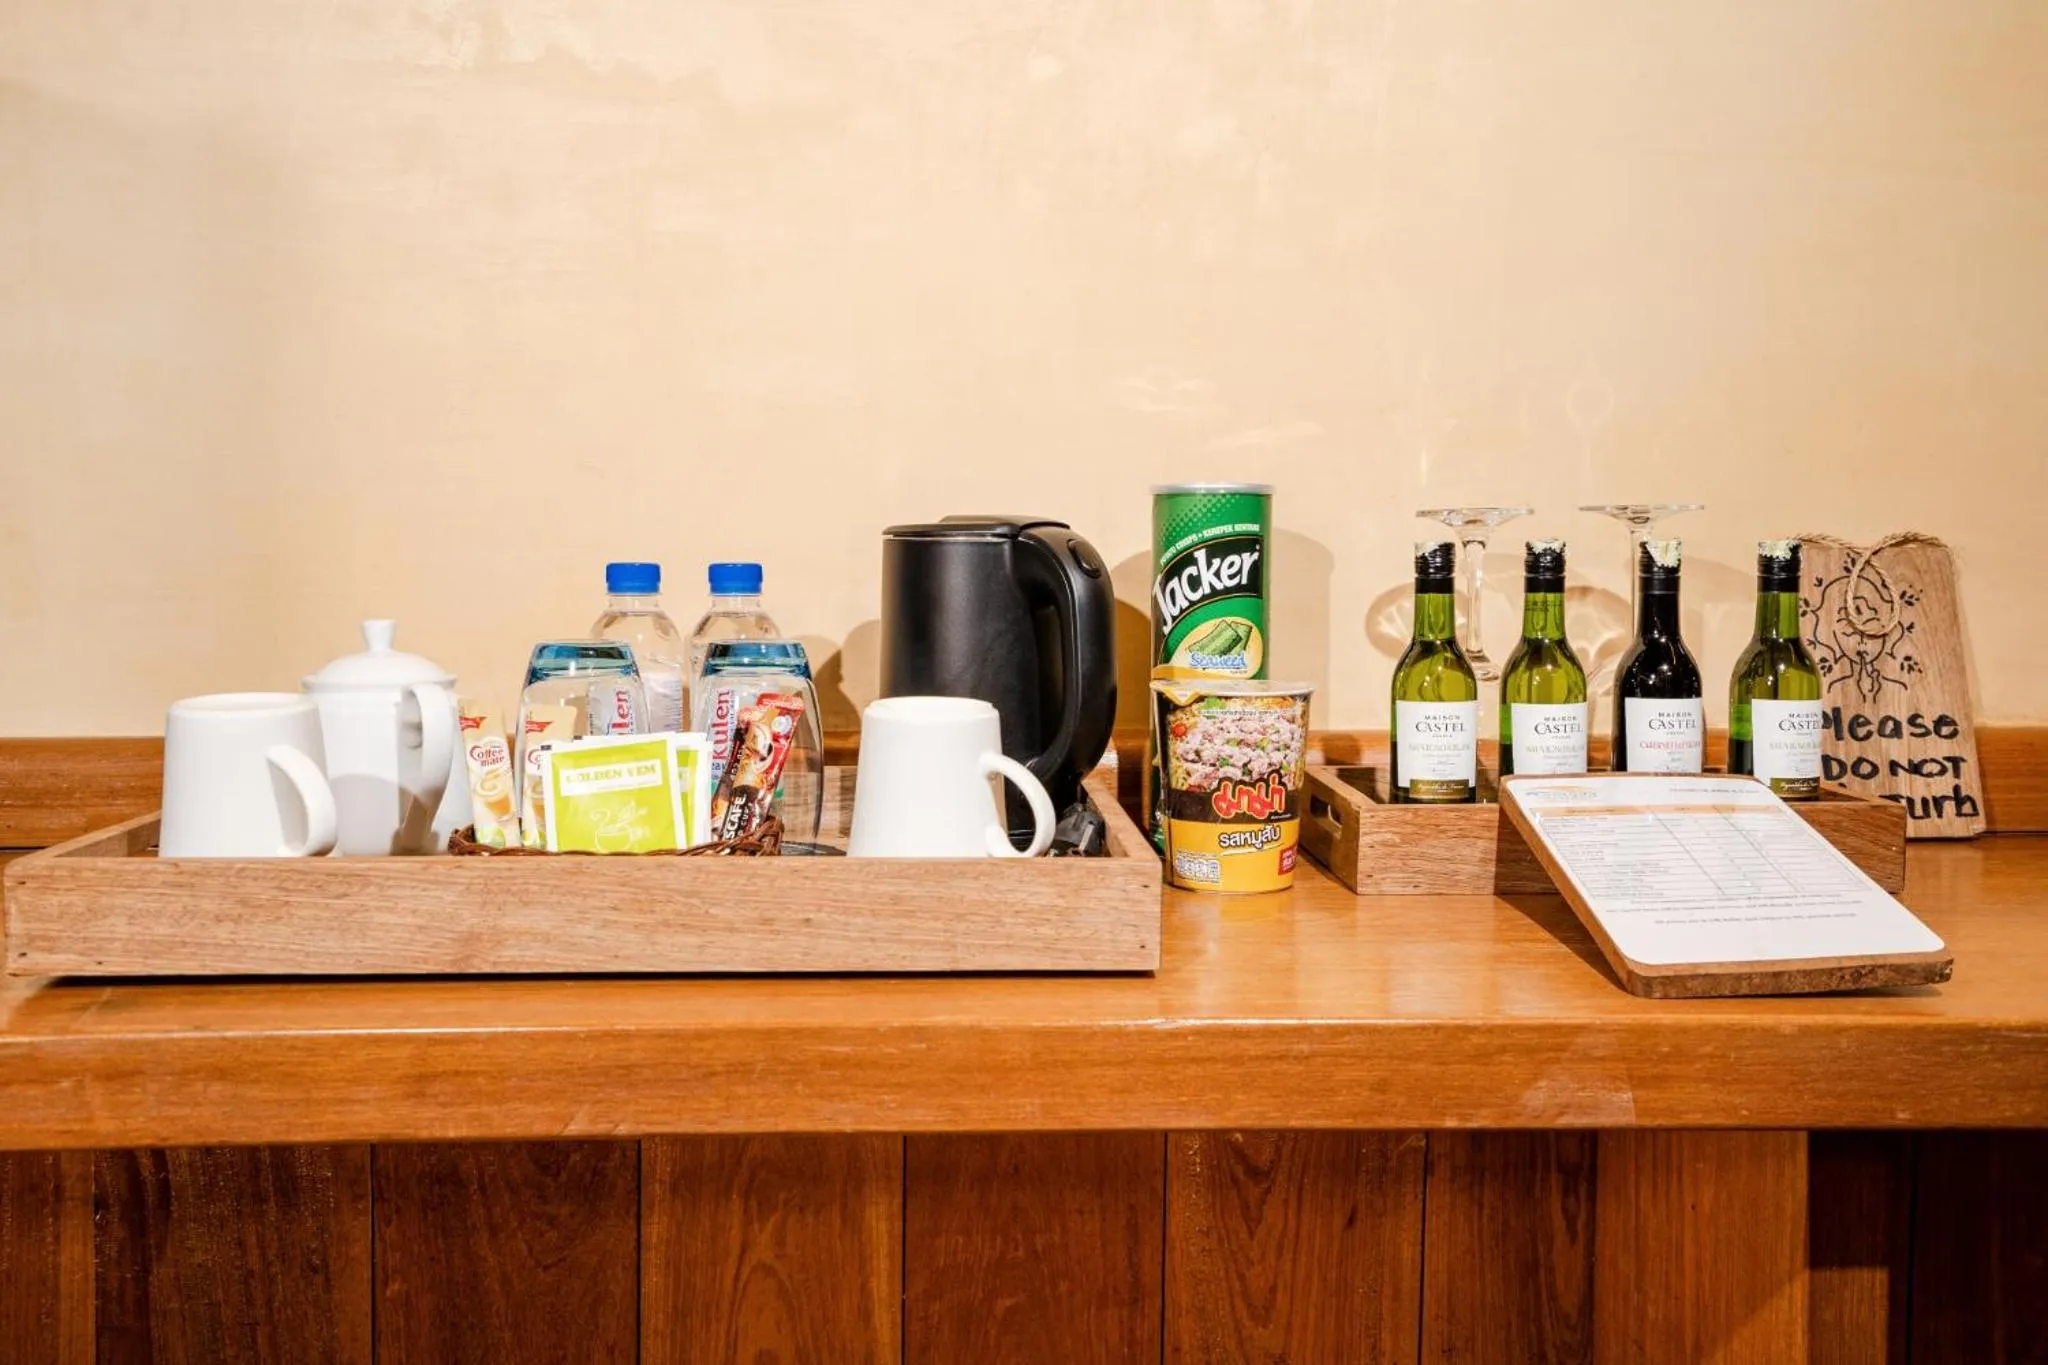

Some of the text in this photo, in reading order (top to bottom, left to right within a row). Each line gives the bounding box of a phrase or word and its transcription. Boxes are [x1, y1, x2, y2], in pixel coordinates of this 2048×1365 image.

[1152, 548, 1260, 635] Jacker
[1190, 650, 1248, 668] Seaweed
[611, 690, 629, 735] len
[1415, 721, 1468, 733] CASTEL
[1534, 722, 1584, 735] CASTEL
[1648, 719, 1698, 730] CASTEL
[1778, 719, 1820, 731] CASTE
[469, 745, 504, 761] Coffee
[481, 756, 505, 767] mate
[1821, 754, 1968, 781] DO NOT
[1212, 773, 1286, 820] มาม่า
[724, 794, 747, 840] SCAFE
[1218, 823, 1281, 849] รสหมูสับ
